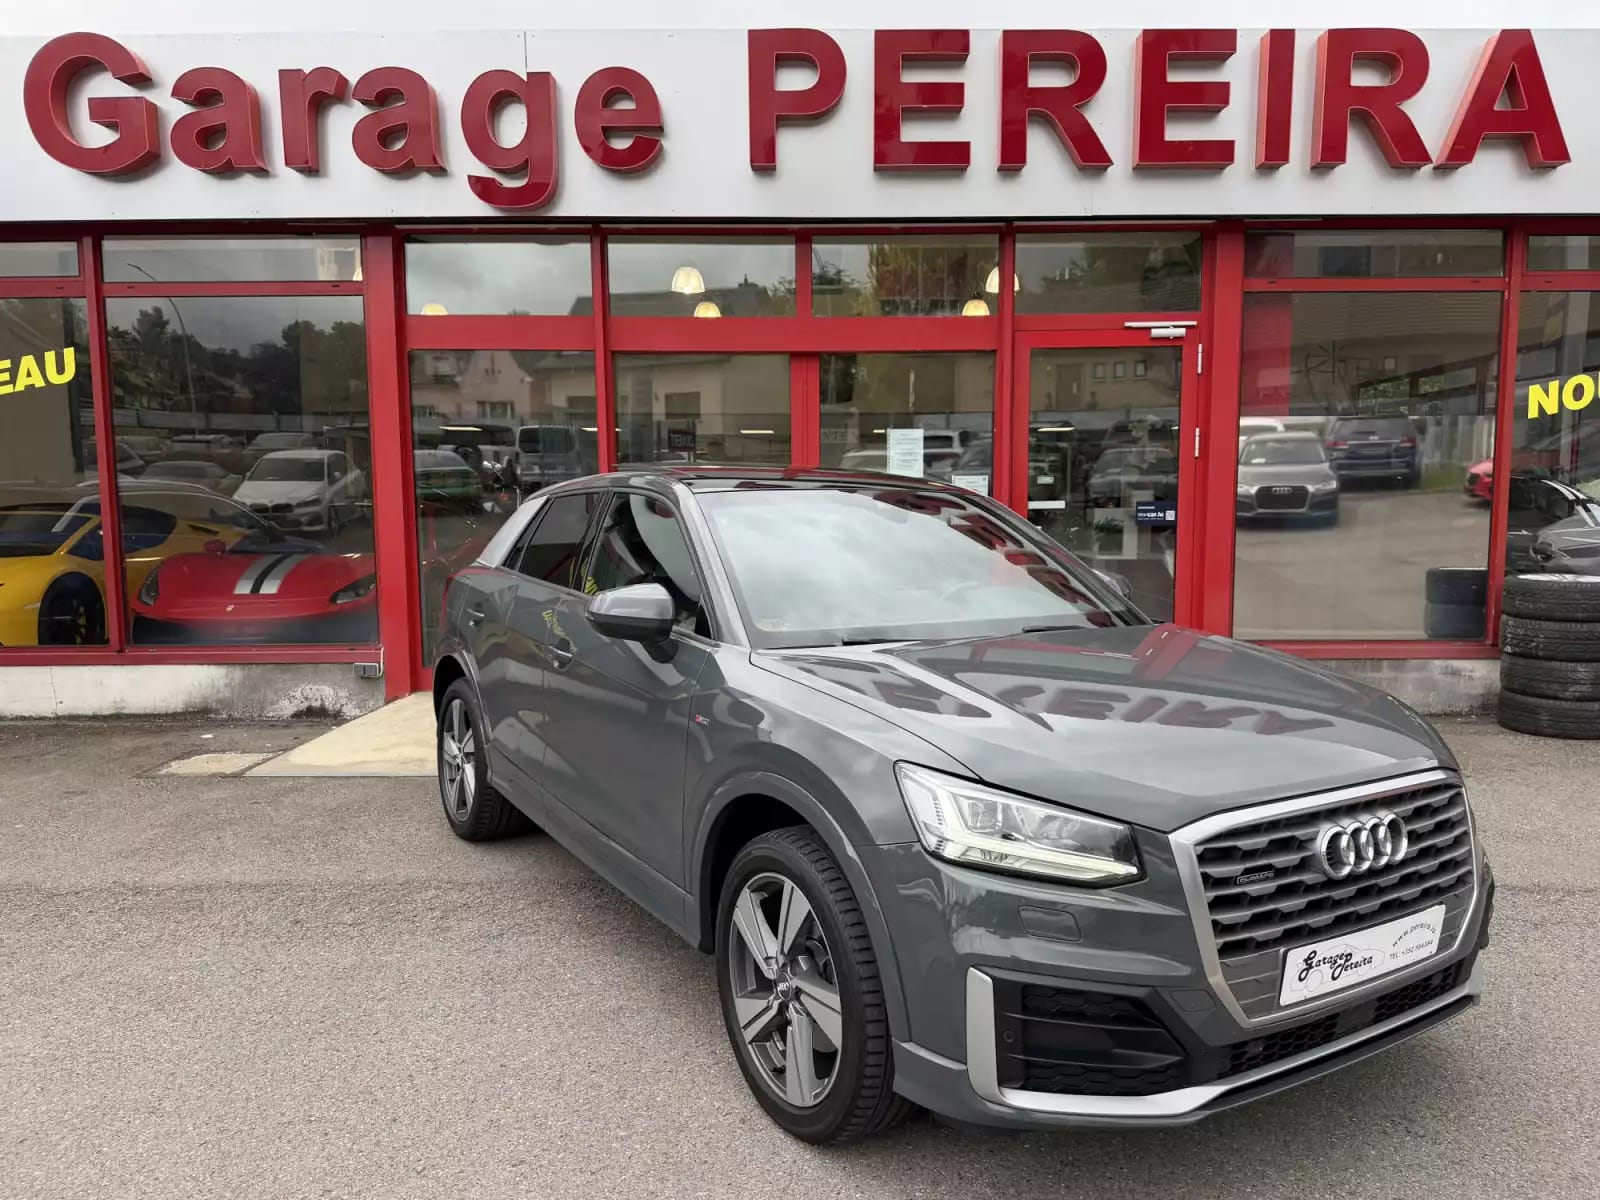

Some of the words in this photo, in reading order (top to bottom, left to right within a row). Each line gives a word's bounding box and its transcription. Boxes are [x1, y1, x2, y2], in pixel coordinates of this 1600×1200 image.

[23, 31, 665, 210] Garage
[747, 28, 1571, 171] PEREIRA
[1527, 372, 1600, 419] NO
[1298, 950, 1345, 982] Garage
